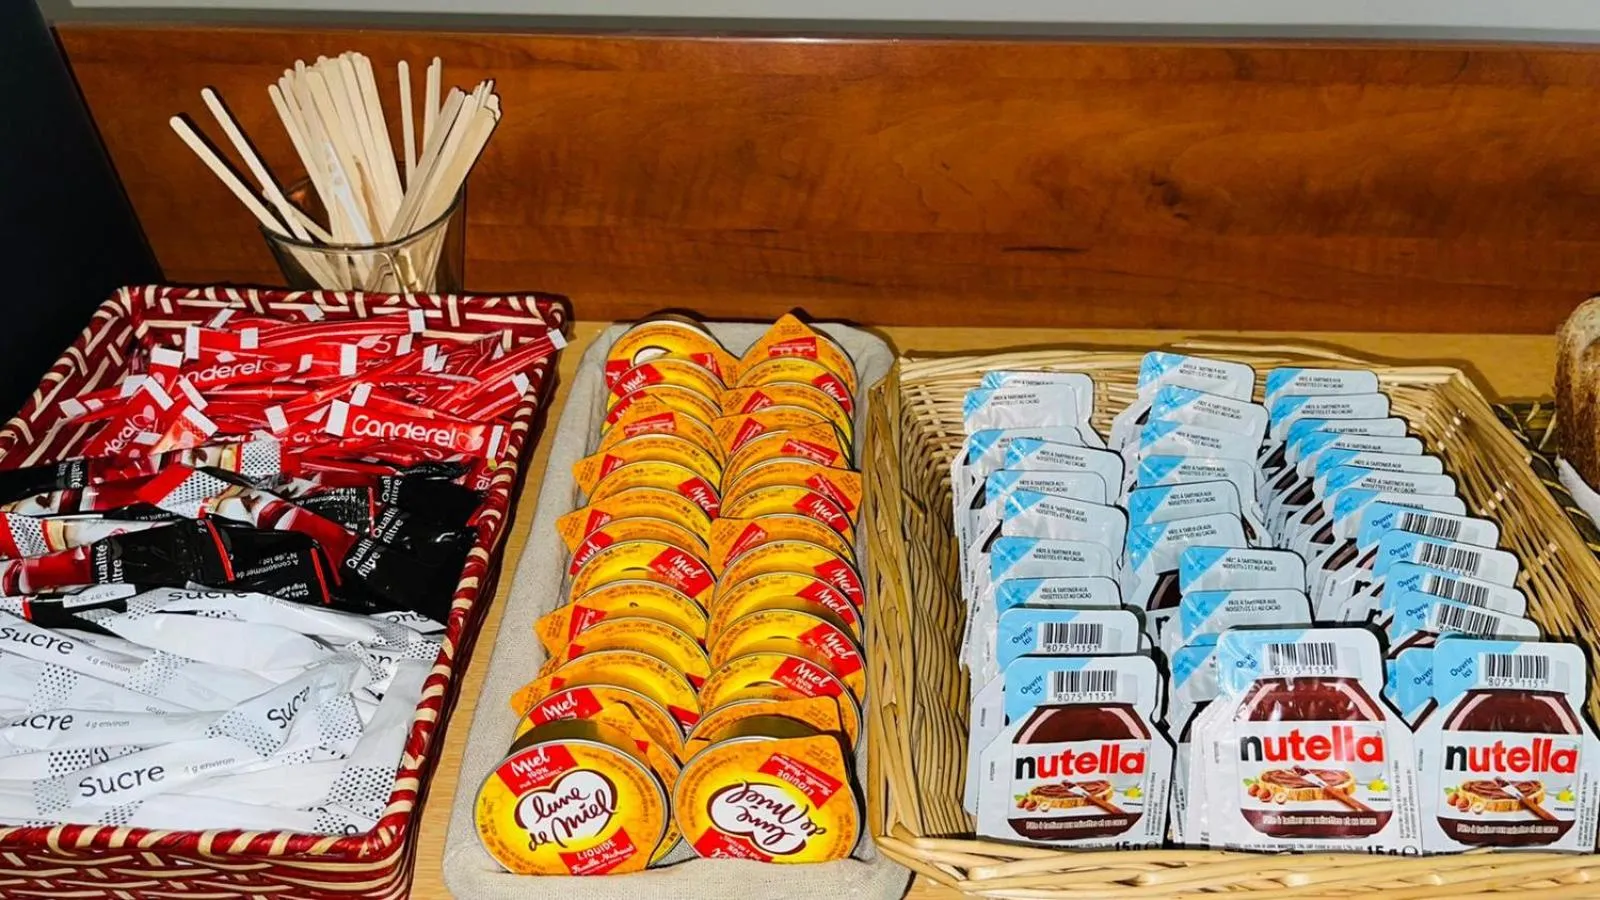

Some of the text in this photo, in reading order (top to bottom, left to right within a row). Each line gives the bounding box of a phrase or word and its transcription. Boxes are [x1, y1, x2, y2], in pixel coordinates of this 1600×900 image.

[181, 359, 262, 382] nderel
[352, 415, 456, 449] Canderel
[690, 486, 719, 511] Miel
[809, 499, 842, 523] Miel
[372, 505, 399, 539] Qualit
[383, 518, 403, 545] filtre
[346, 538, 373, 569] Qualit
[357, 550, 381, 578] filtre
[668, 554, 705, 579] Miel
[112, 558, 123, 583] ltre
[831, 566, 860, 595] Miel
[815, 588, 850, 614] Miel
[820, 632, 857, 660] Miel
[793, 662, 832, 689] Miel
[1413, 667, 1433, 685] Ouvri
[1450, 657, 1473, 677] Ouvrir
[1020, 675, 1043, 695] Ouvrir
[1488, 678, 1514, 687] 8075
[541, 691, 578, 721] Miel
[1057, 693, 1113, 701] 8075 1151
[11, 714, 74, 730] ucre
[1240, 725, 1385, 763] nutella
[1445, 737, 1578, 774] nutella
[510, 746, 551, 778] Miel
[1015, 744, 1146, 780] nutella
[79, 764, 165, 798] Sucre
[528, 830, 554, 852] de
[1367, 845, 1384, 855] 15
